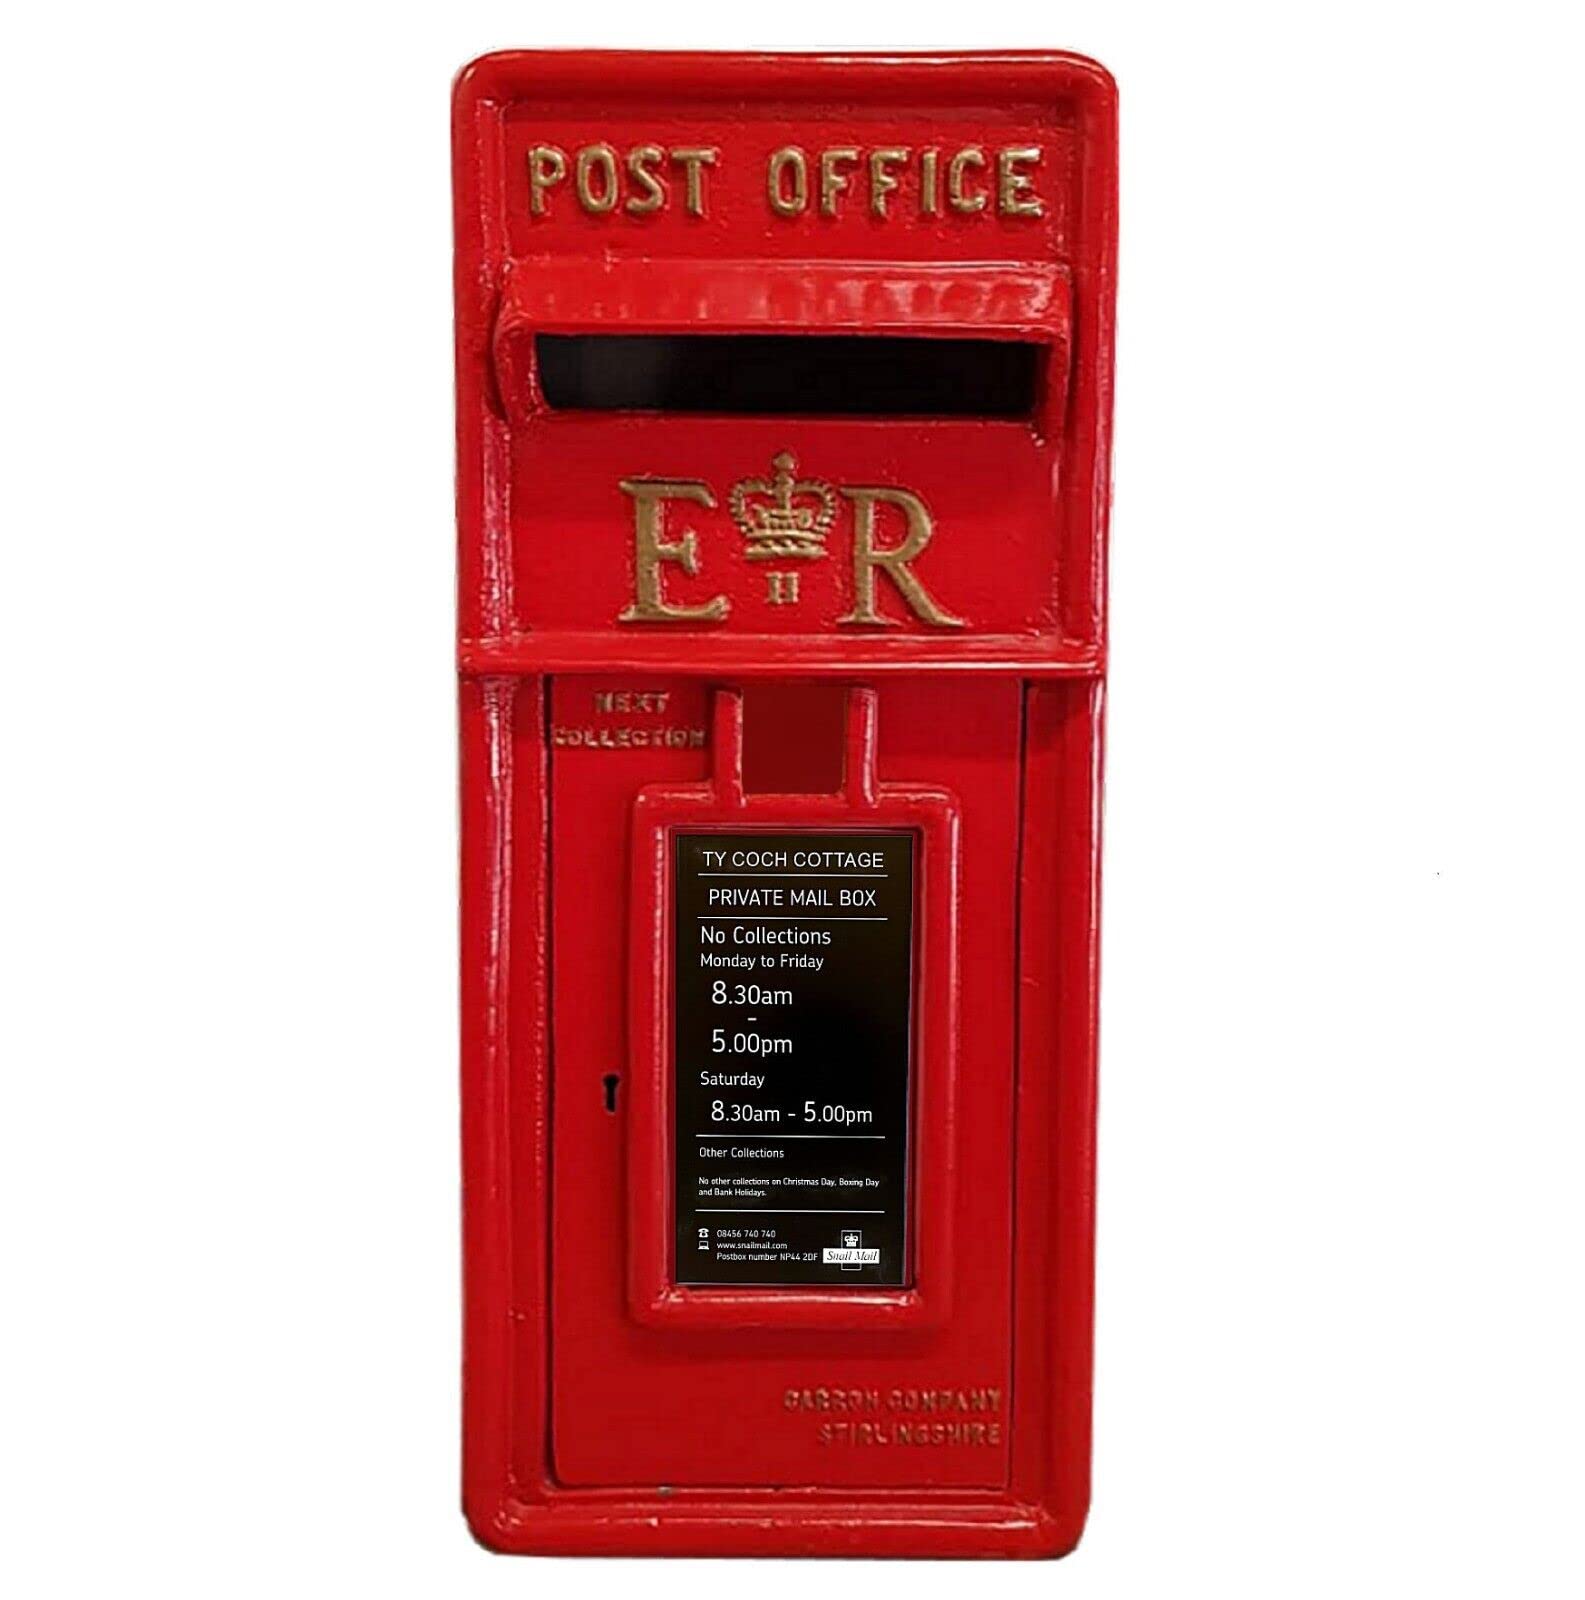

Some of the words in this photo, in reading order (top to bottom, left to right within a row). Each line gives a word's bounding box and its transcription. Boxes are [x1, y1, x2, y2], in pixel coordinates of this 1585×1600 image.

[527, 142, 718, 217] POST
[768, 145, 1048, 218] OFFICE
[619, 477, 730, 626] E
[838, 484, 968, 629] R
[595, 691, 670, 713] NEXT
[554, 727, 706, 748] COLLECTION
[703, 852, 726, 866] TY
[733, 852, 786, 866] COCH
[794, 852, 883, 867] COTTAGE
[710, 889, 783, 905] PRIVATE
[791, 890, 833, 905] MAIL
[840, 890, 876, 906] BOX
[702, 926, 725, 943] No
[734, 926, 831, 944] Collections
[701, 953, 755, 970] Monday
[761, 955, 774, 967] to
[781, 954, 823, 971] Friday
[712, 981, 792, 1004] 8.30am
[712, 1029, 792, 1057] 5.00pm
[701, 1071, 764, 1088] Saturday
[712, 1100, 779, 1121] 8.30am
[805, 1101, 872, 1126] 5.00pm
[700, 1147, 727, 1157] Other
[731, 1148, 784, 1158] Collections
[821, 1178, 836, 1187] Day,
[840, 1178, 863, 1187] Boxing
[866, 1178, 879, 1187] Day
[735, 1189, 766, 1197] Holidays.
[827, 1250, 851, 1261] Snail
[854, 1250, 877, 1261] Mail
[887, 1387, 1001, 1412] COMPANY
[818, 1422, 1000, 1445] STIRLINGSHIRE
